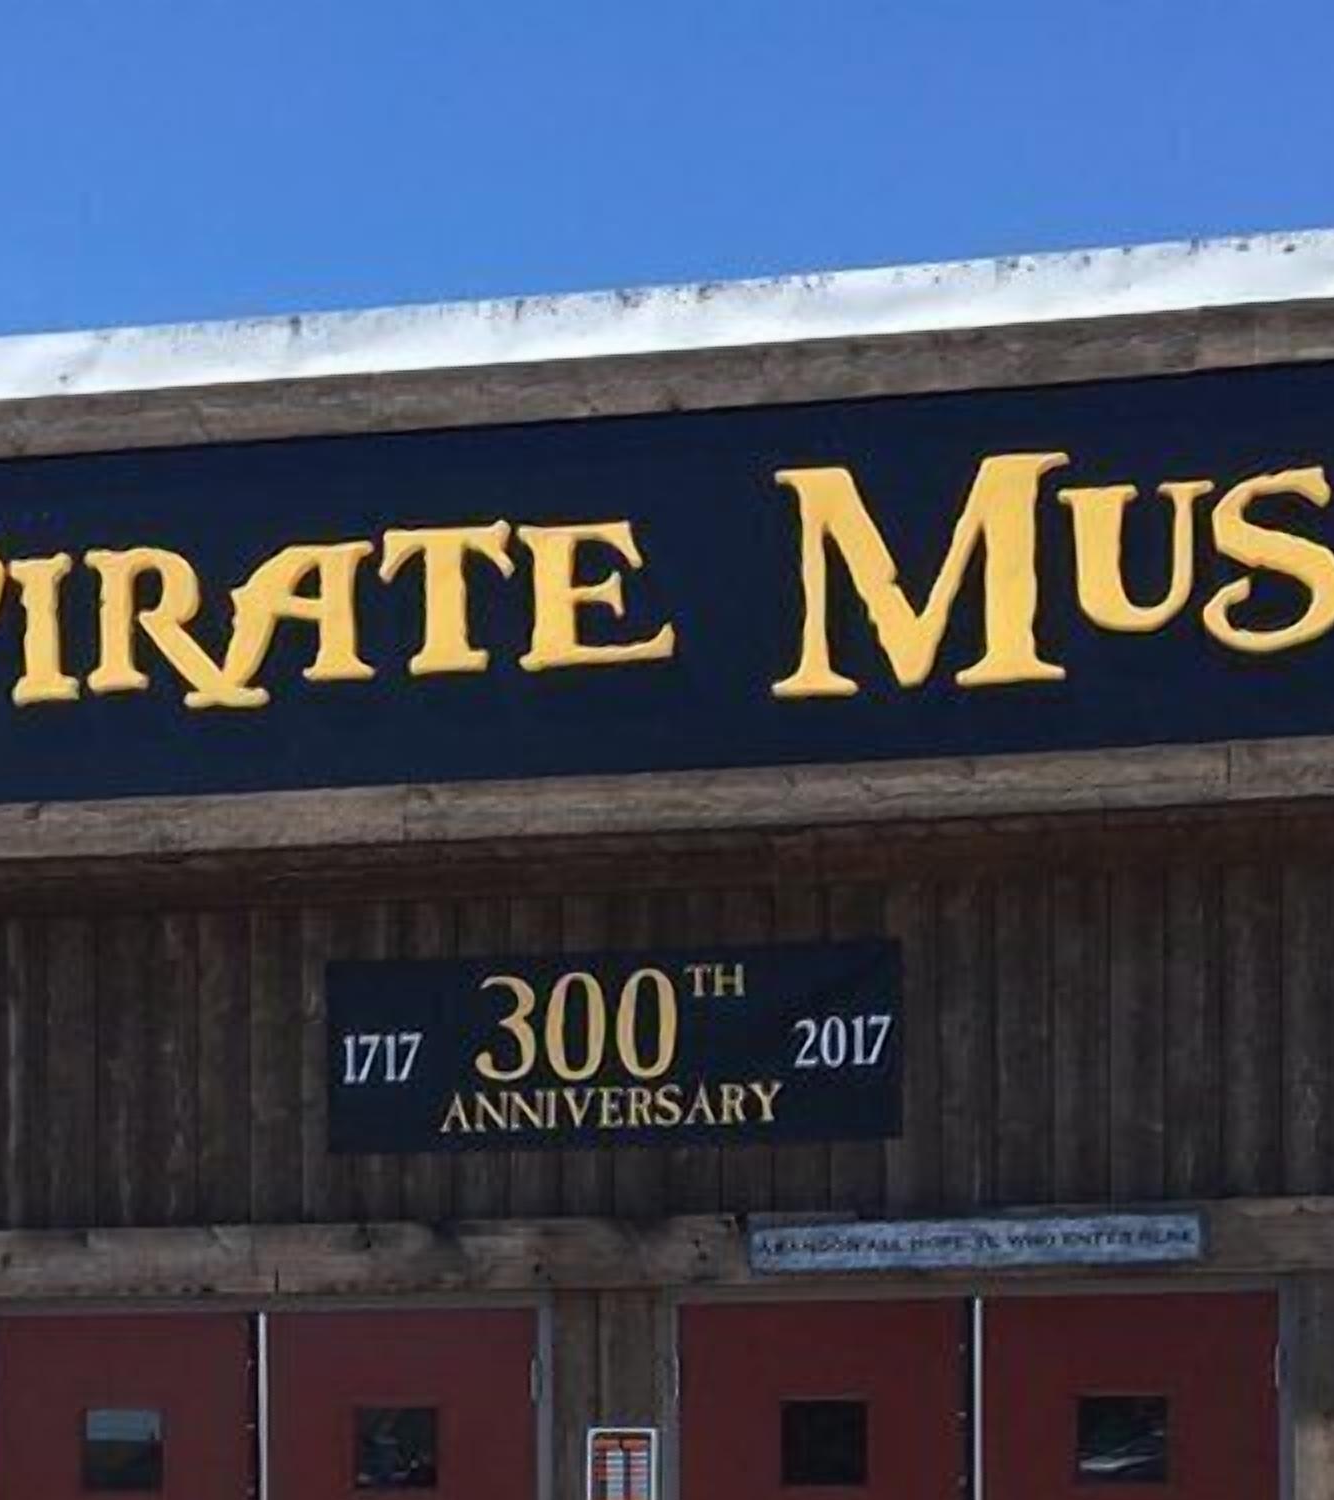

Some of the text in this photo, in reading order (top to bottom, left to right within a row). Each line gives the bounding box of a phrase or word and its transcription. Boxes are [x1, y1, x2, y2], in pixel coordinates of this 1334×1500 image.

[342, 1031, 424, 1084] 1717
[793, 1014, 893, 1069] 2017
[439, 1080, 784, 1133] ANNIVERSARY
